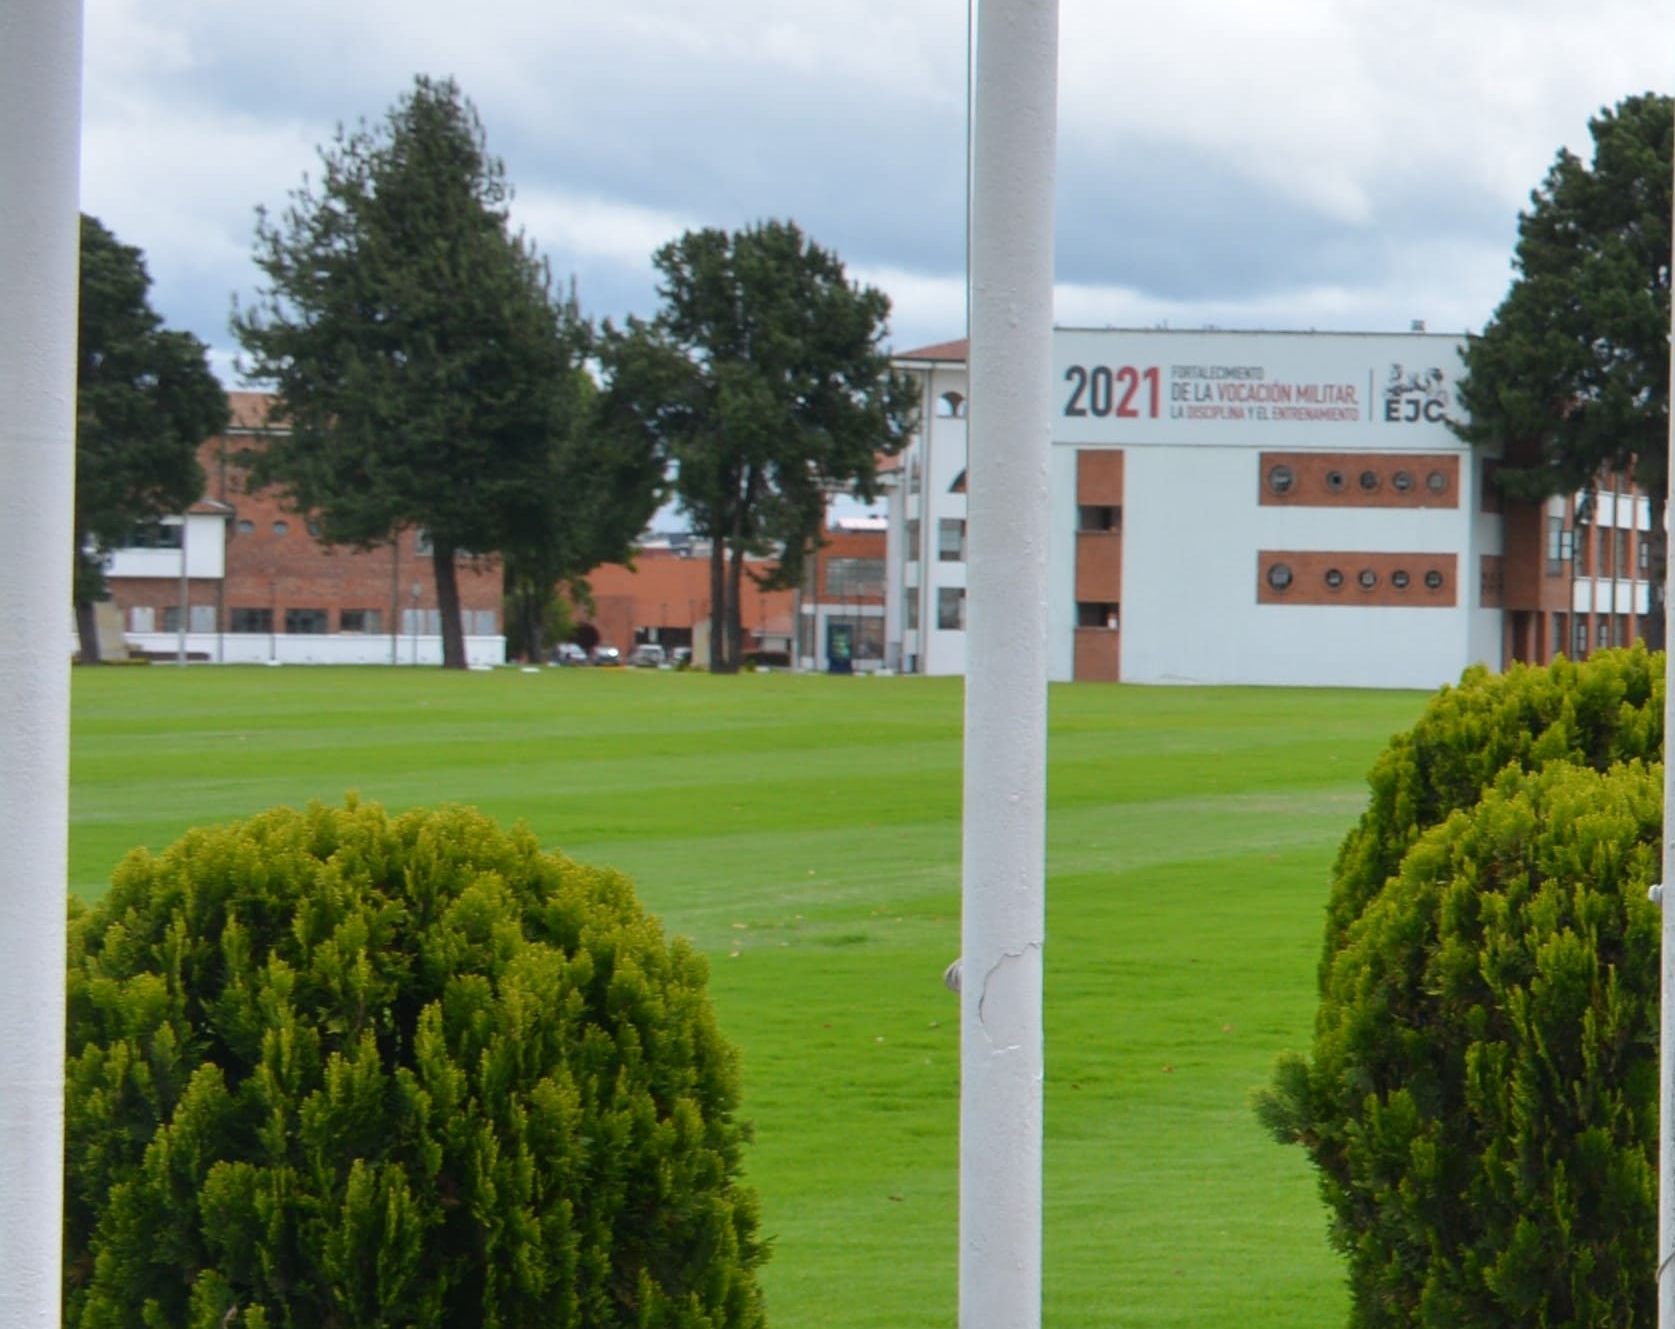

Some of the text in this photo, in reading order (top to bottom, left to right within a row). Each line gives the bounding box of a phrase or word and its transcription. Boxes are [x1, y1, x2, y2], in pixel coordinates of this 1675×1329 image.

[1064, 365, 1160, 418] 2021
[1171, 382, 1191, 402] DE
[1194, 382, 1214, 402] LA
[1217, 379, 1292, 403] VOCACIÓN
[1170, 406, 1184, 420] LA
[1187, 406, 1244, 421] DISCIPLINA
[1256, 406, 1270, 421] EL
[1272, 406, 1359, 422] ENTRENAMIENTO
[1385, 399, 1445, 422] EJC
